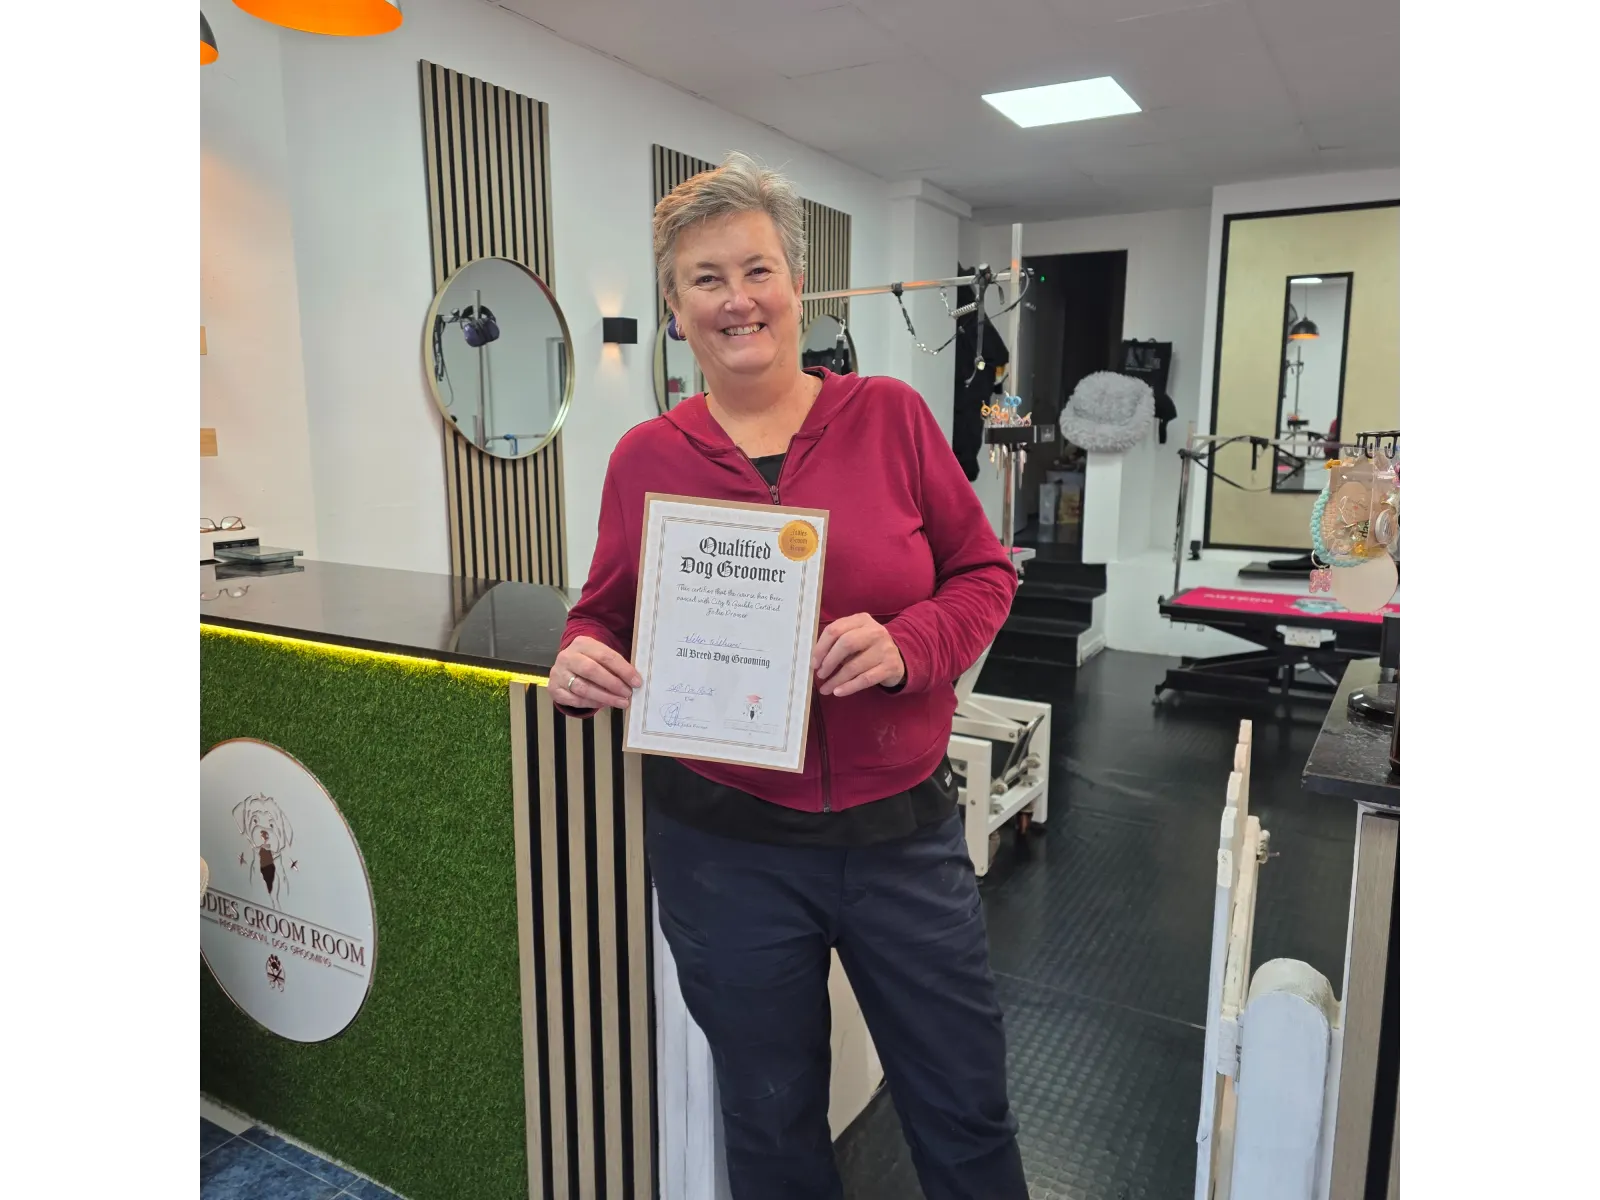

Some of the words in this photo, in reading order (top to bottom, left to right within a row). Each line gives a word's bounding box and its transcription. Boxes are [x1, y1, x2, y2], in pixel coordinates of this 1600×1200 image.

[699, 537, 771, 560] Qualified
[679, 556, 713, 579] Dog
[717, 560, 786, 584] Groomer
[676, 584, 690, 592] This
[691, 586, 714, 595] certifies
[714, 588, 727, 596] that
[727, 589, 736, 597] the
[756, 592, 768, 600] has
[711, 598, 725, 608] City
[731, 600, 753, 609] Guilds
[754, 602, 780, 612] Certified
[676, 648, 688, 658] All
[688, 649, 712, 660] Breed
[713, 652, 730, 664] Dog
[731, 654, 771, 669] Grooming
[217, 918, 269, 945] PROFESSIONAL
[271, 937, 288, 952] DOG
[290, 945, 332, 968] GROOMING
[244, 906, 306, 945] GROOM
[310, 928, 366, 967] ROOM
